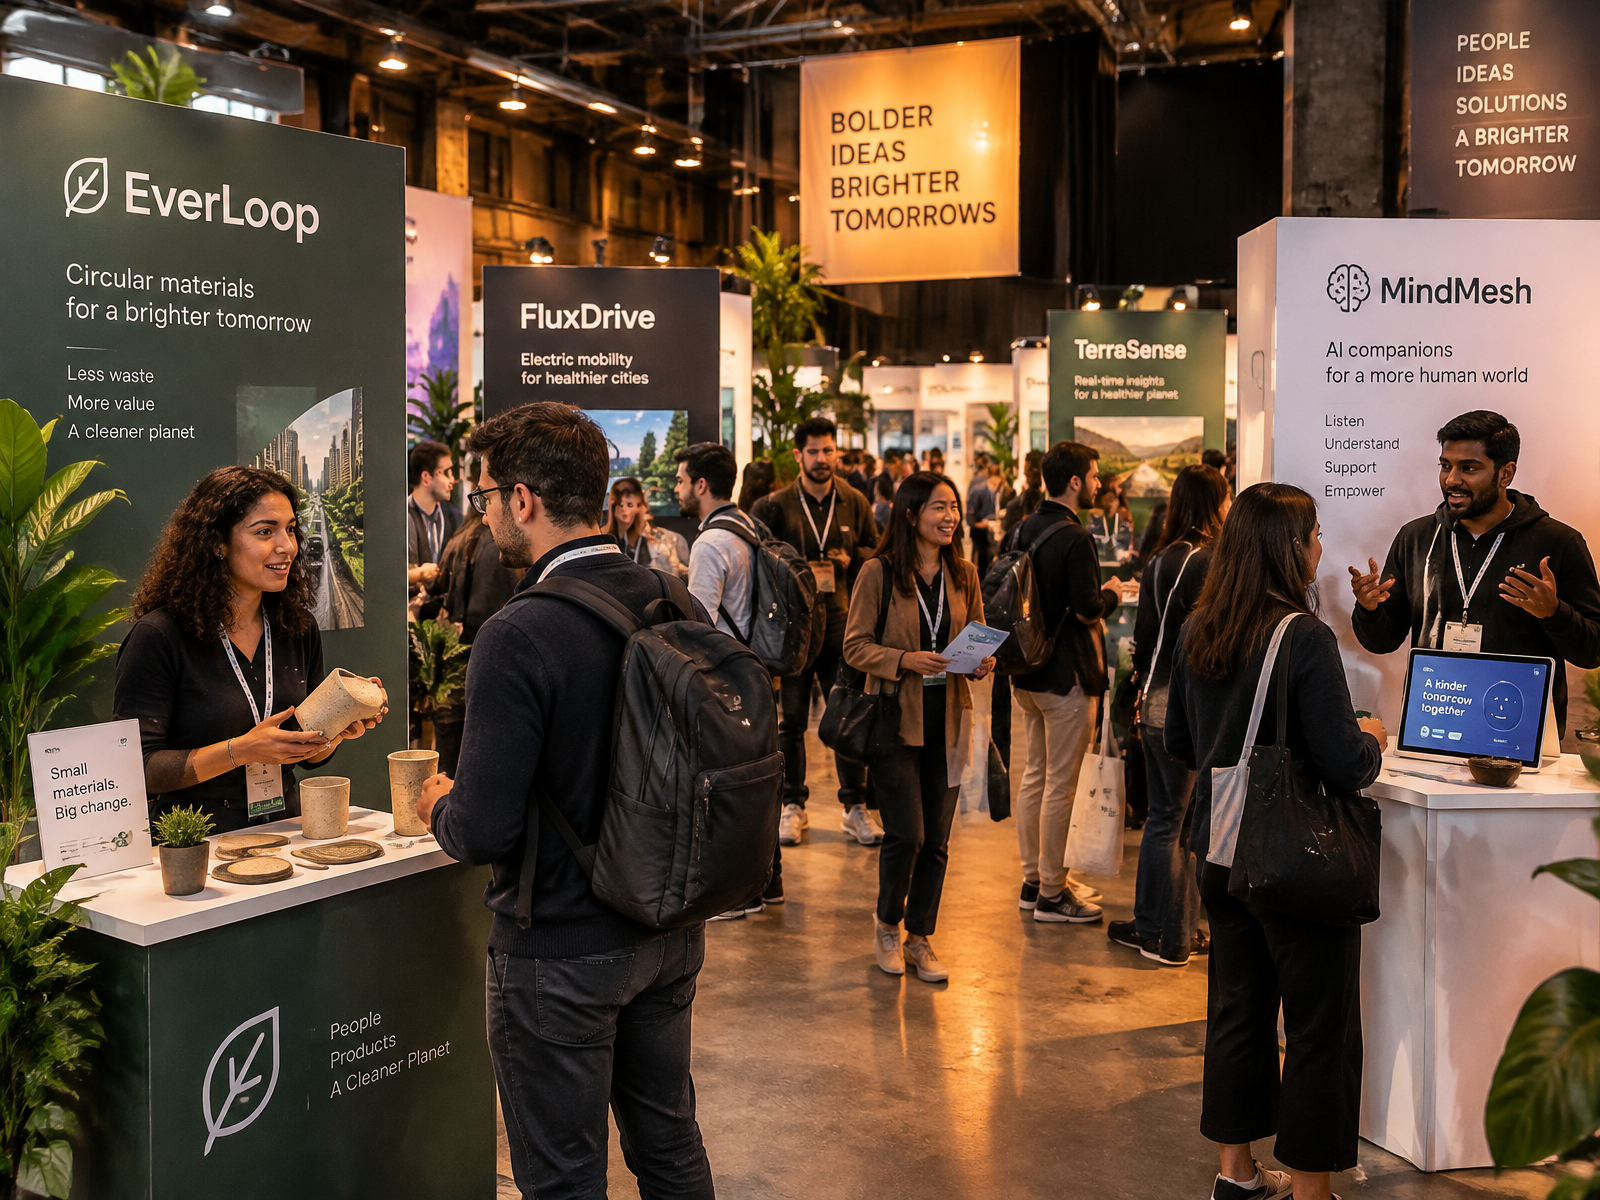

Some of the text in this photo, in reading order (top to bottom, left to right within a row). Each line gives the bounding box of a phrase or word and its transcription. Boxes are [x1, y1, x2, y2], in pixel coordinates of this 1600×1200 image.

[1457, 31, 1530, 52] PEOPLE
[1457, 62, 1514, 83] IDEAS
[1456, 93, 1567, 115] SOLUTIONS
[831, 105, 933, 134] BOLDER
[1455, 125, 1569, 148] A BRIGHTER
[831, 140, 906, 166] IDEAS
[1456, 154, 1577, 178] TOMORROW
[831, 171, 959, 198] BRIGHTER
[125, 170, 320, 243] EverLoop
[831, 202, 996, 232] TOMORROWS
[66, 263, 255, 300] Circular materials
[1381, 276, 1532, 304] MindMesh
[66, 296, 312, 334] for a brighter tomorrow
[520, 302, 656, 330] FluxDrive
[1074, 338, 1187, 360] TerraSense
[1326, 340, 1453, 361] AI companions
[520, 352, 633, 368] Electric mobility
[67, 364, 154, 383] Less waste
[520, 371, 650, 384] for healthier cities
[1126, 374, 1165, 388] insights
[1326, 366, 1529, 383] for a more human world
[68, 394, 155, 411] More value
[1074, 388, 1179, 402] for a healthier planet
[1325, 414, 1364, 427] Listen
[67, 423, 80, 439] A
[149, 424, 196, 442] planet
[1324, 437, 1400, 450] Understand
[1324, 460, 1377, 476] Support
[1324, 484, 1385, 499] Empower
[1424, 678, 1468, 692] A kinder
[1422, 703, 1466, 716] together
[50, 762, 88, 780] Small
[53, 778, 118, 800] materials.
[56, 796, 132, 821] Big change.
[330, 1011, 382, 1040] People
[330, 1034, 396, 1069] Products
[330, 1040, 450, 1099] A Cleaner Planet
